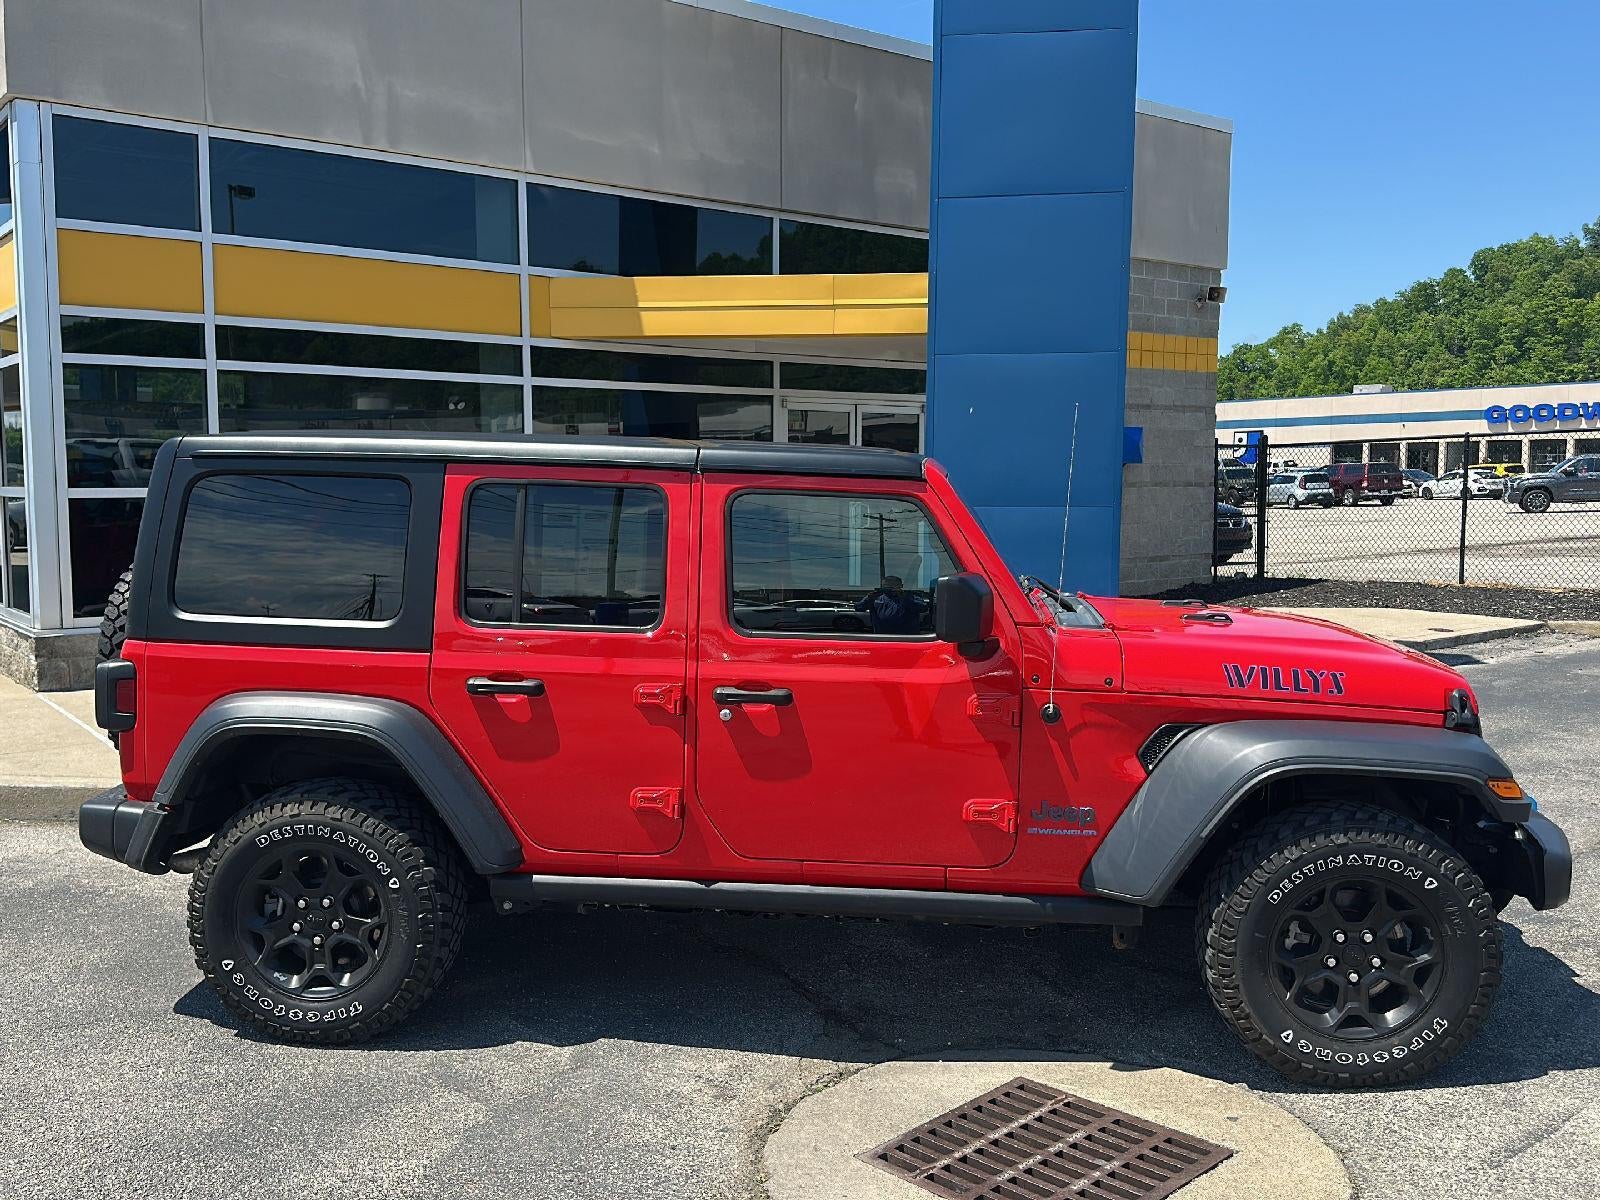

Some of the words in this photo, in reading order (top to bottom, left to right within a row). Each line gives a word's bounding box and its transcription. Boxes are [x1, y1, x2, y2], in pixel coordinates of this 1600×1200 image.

[1222, 663, 1346, 695] WILLYS
[1031, 800, 1096, 827] Jeep
[256, 824, 391, 875] DESTINATION
[1268, 854, 1422, 904] DESTINATION
